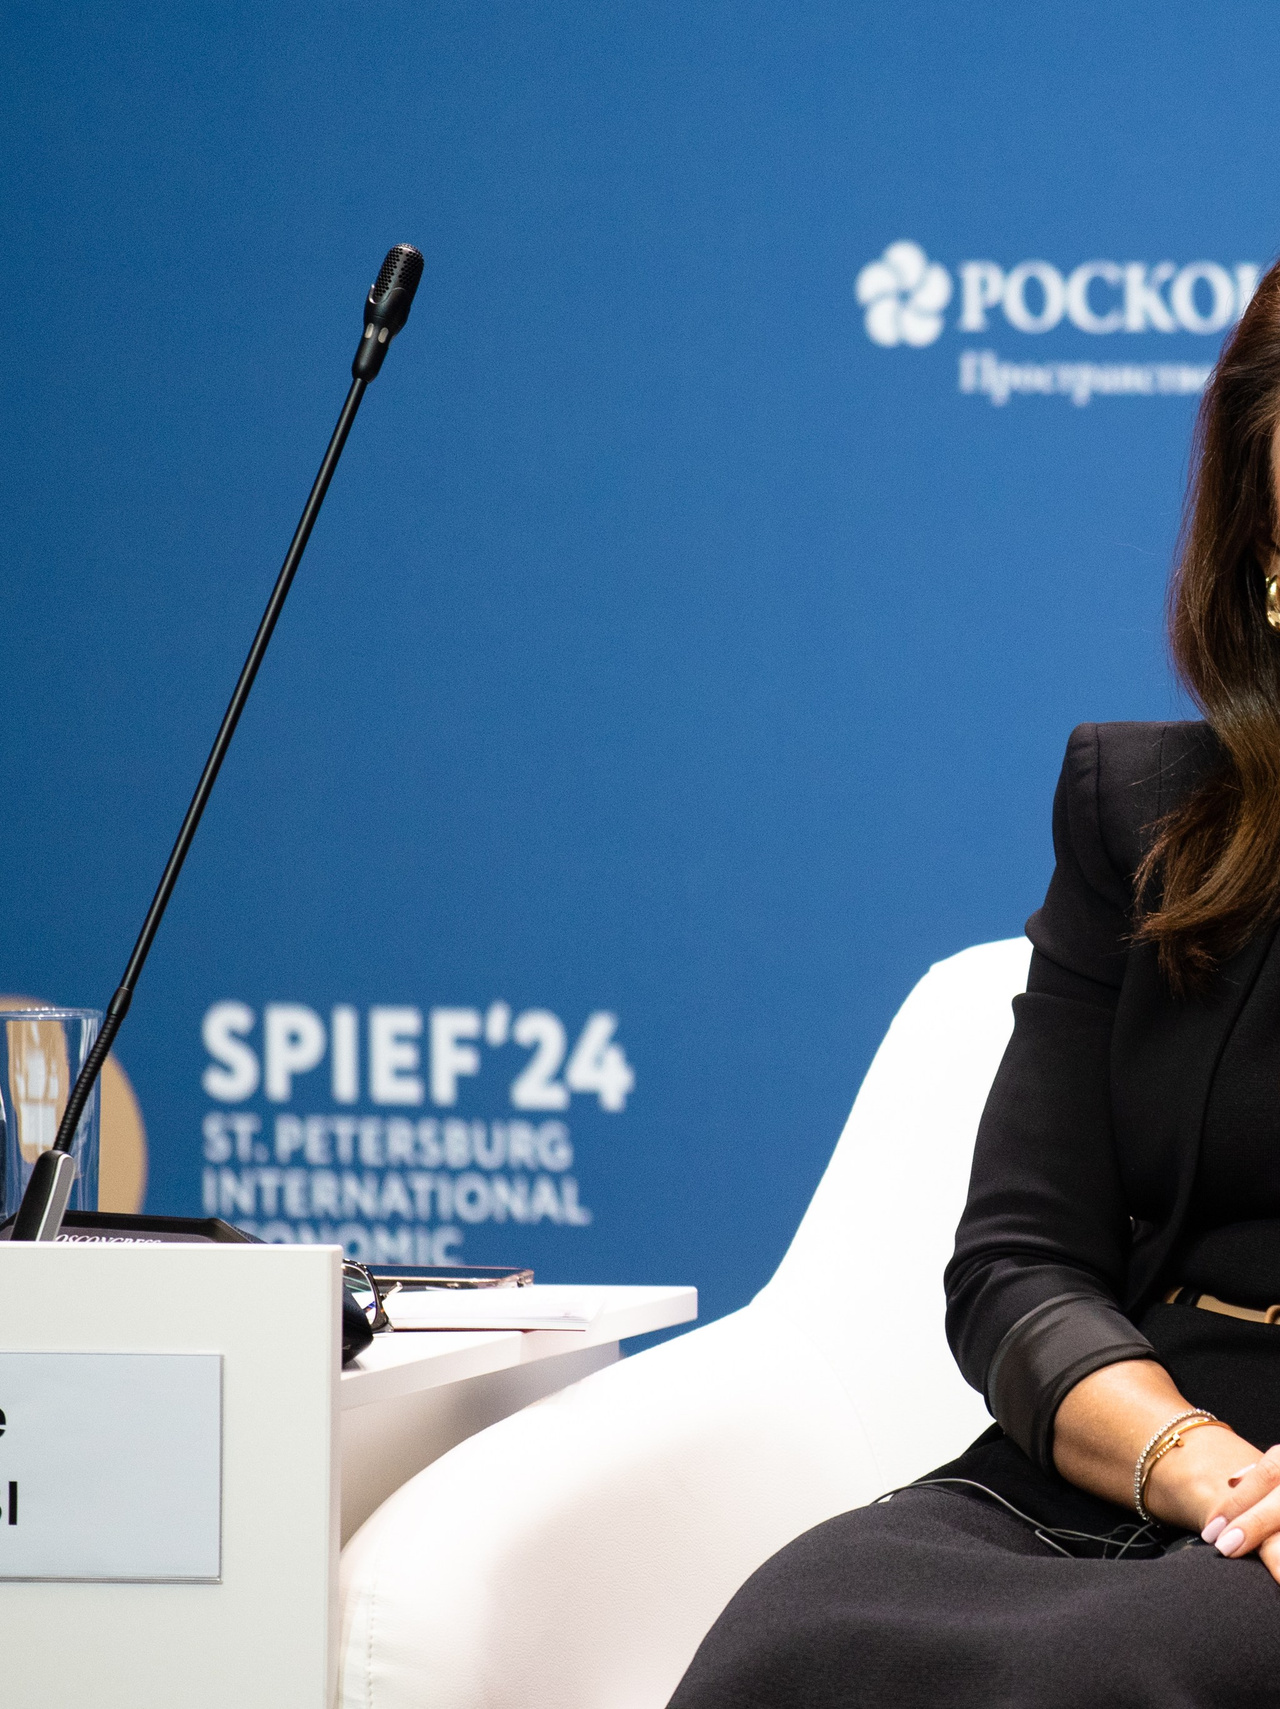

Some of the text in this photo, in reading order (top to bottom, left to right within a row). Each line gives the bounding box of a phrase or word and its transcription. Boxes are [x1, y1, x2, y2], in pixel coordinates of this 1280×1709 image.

[203, 1112, 573, 1172] ST. PETERSBURG
[202, 1167, 591, 1226] INTERNATIONAL
